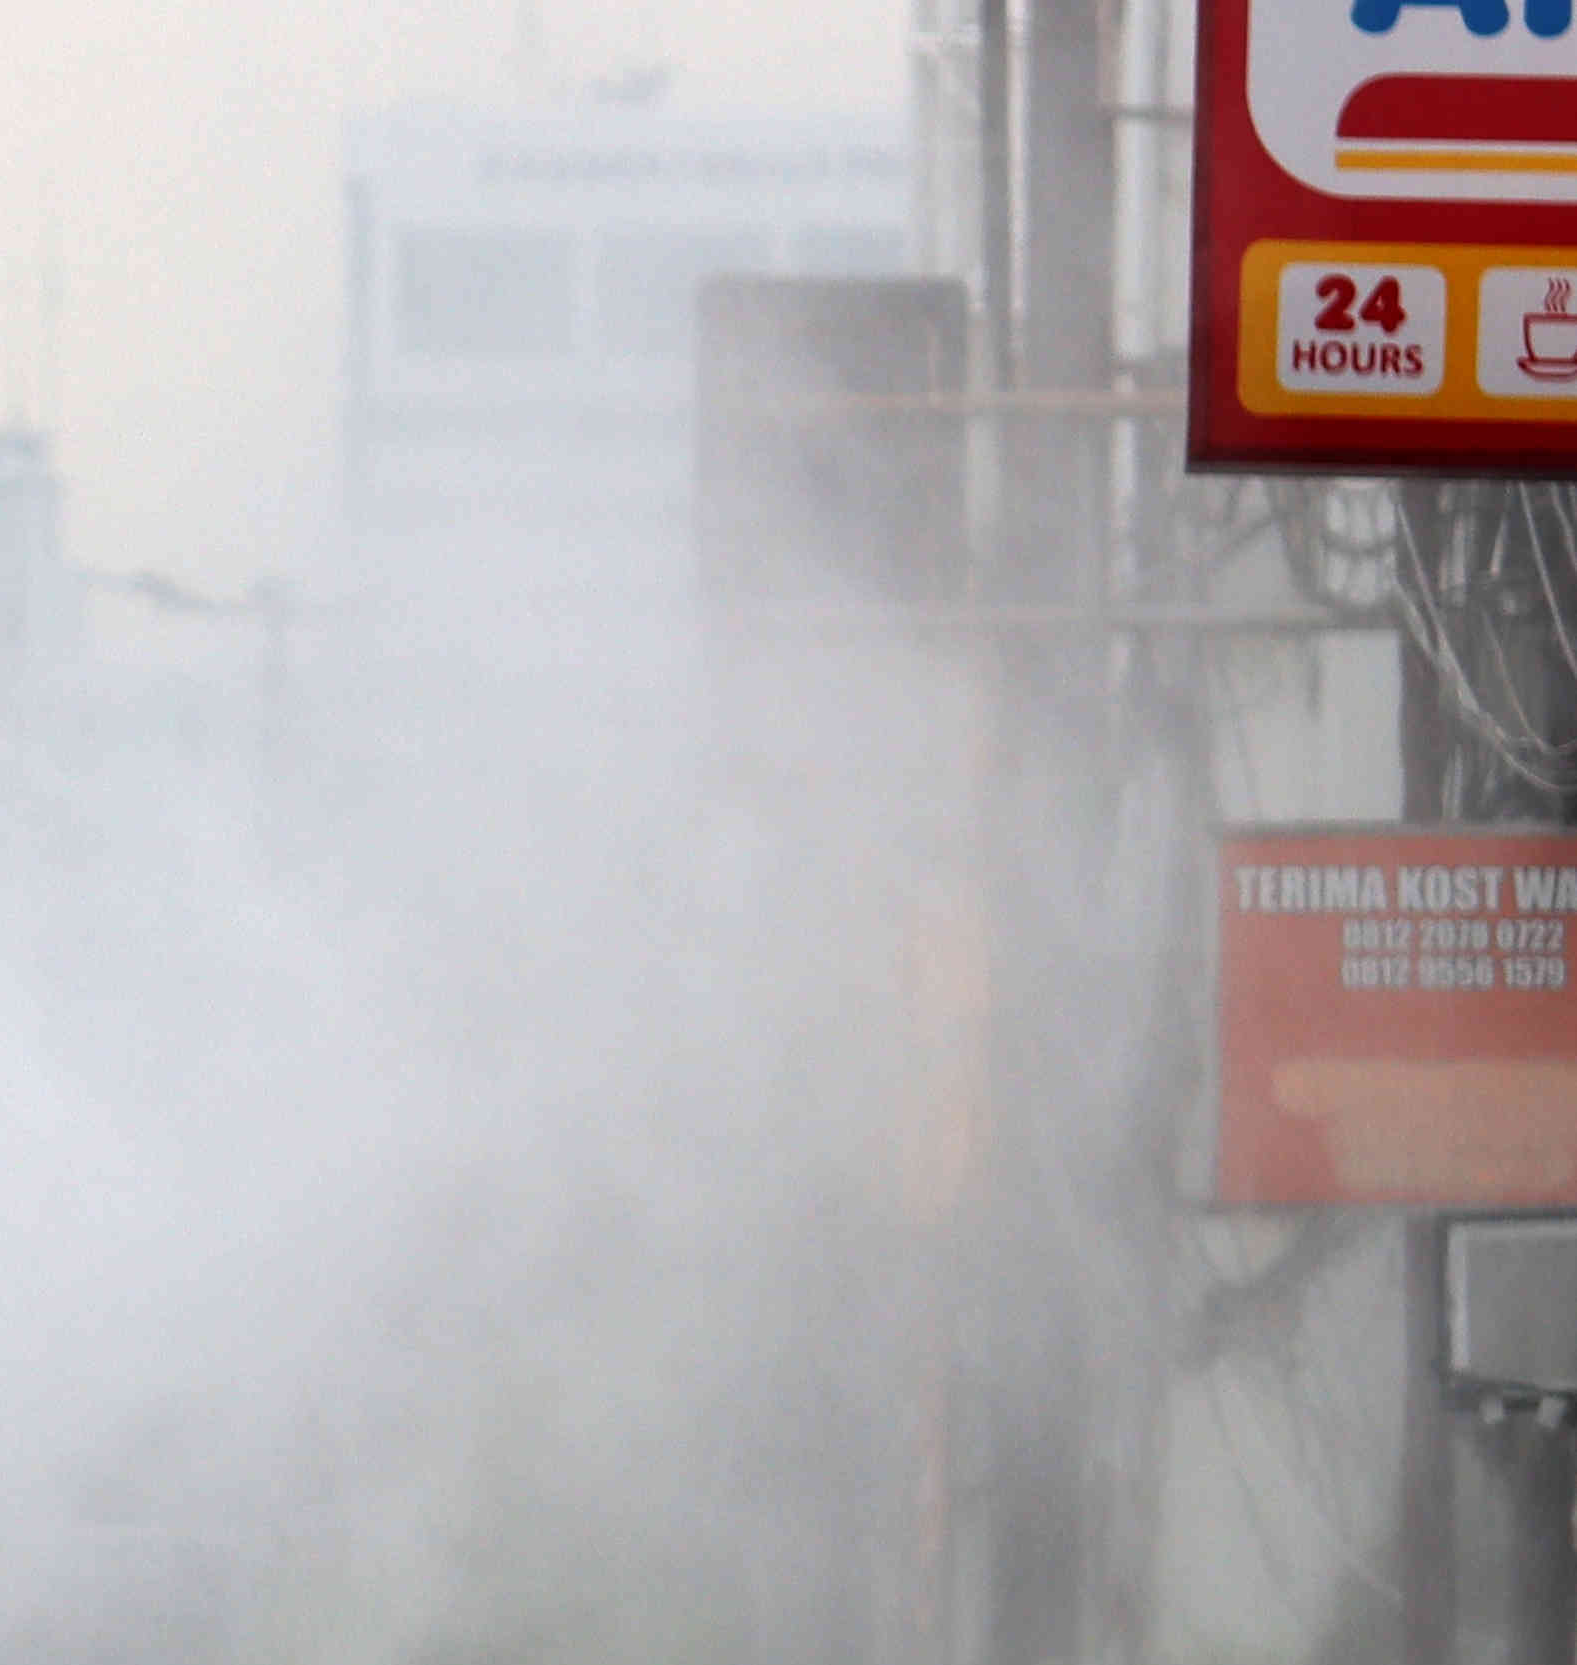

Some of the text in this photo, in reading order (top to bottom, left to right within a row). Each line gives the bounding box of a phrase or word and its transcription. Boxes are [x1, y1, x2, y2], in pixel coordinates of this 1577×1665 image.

[1315, 273, 1406, 335] 24
[1292, 339, 1424, 377] HOURS
[1234, 865, 1387, 912] TERIMA
[1398, 865, 1503, 912] KOST
